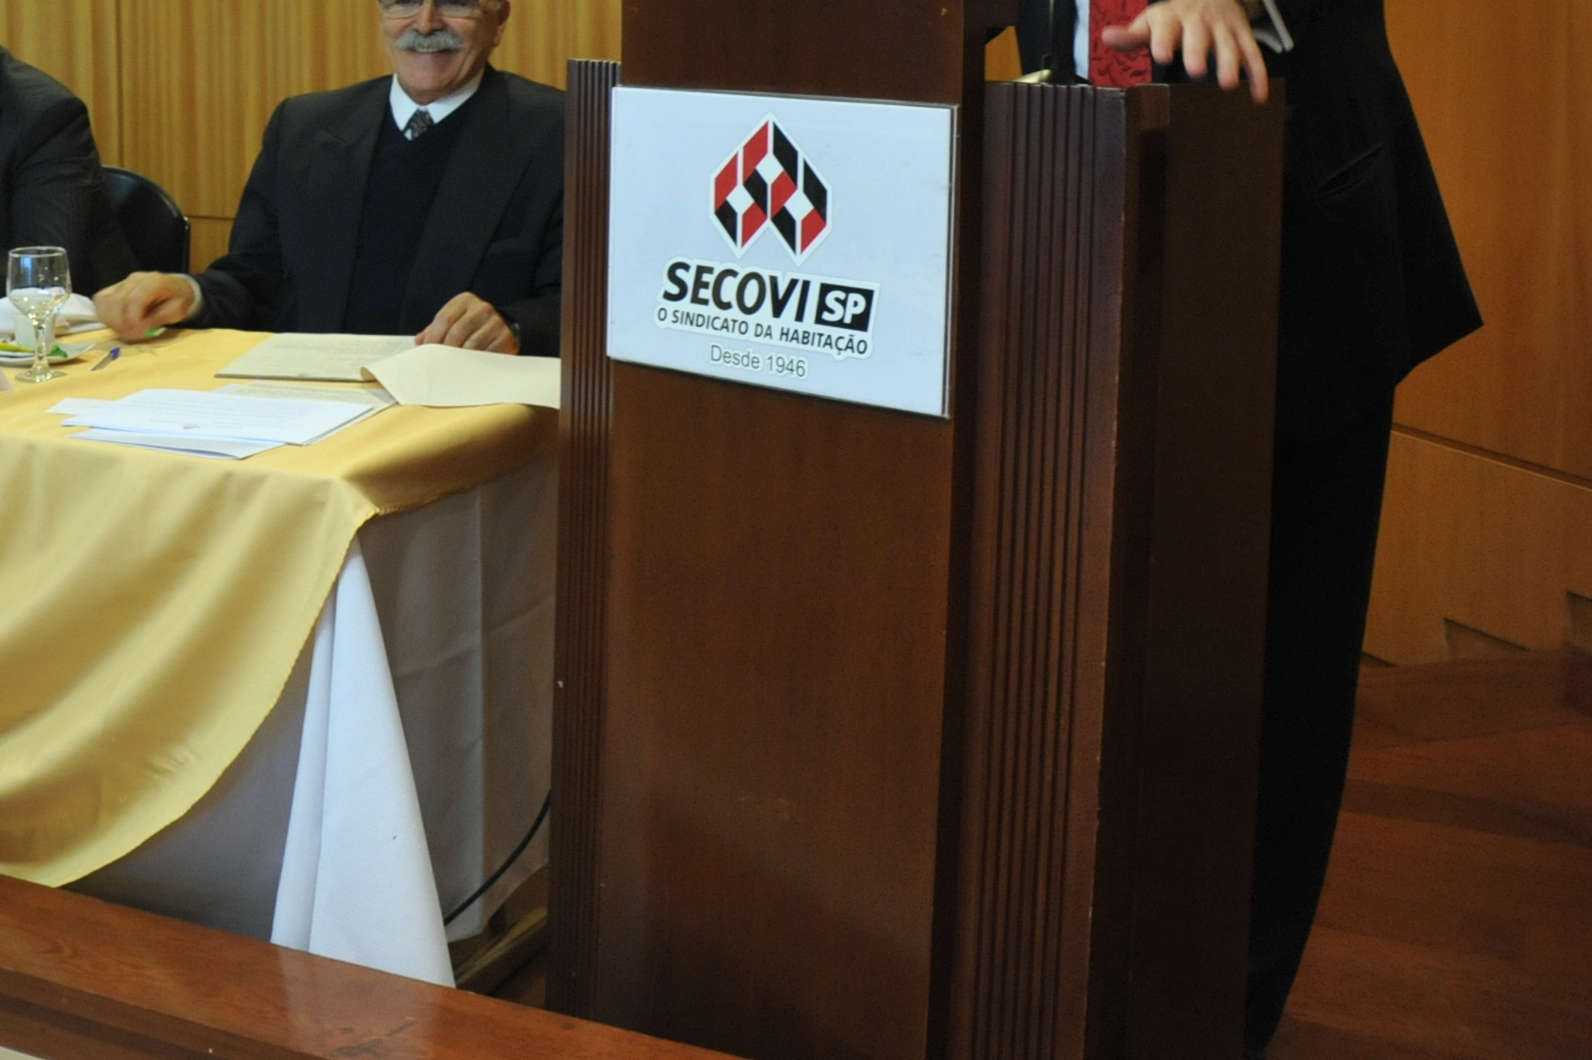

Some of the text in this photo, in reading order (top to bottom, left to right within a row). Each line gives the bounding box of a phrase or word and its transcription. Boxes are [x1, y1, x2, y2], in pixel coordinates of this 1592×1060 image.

[662, 261, 869, 325] SECOVI SP
[657, 307, 868, 355] O SINDICATO DA HABITAÇÃO
[710, 344, 806, 377] Desde 1946
